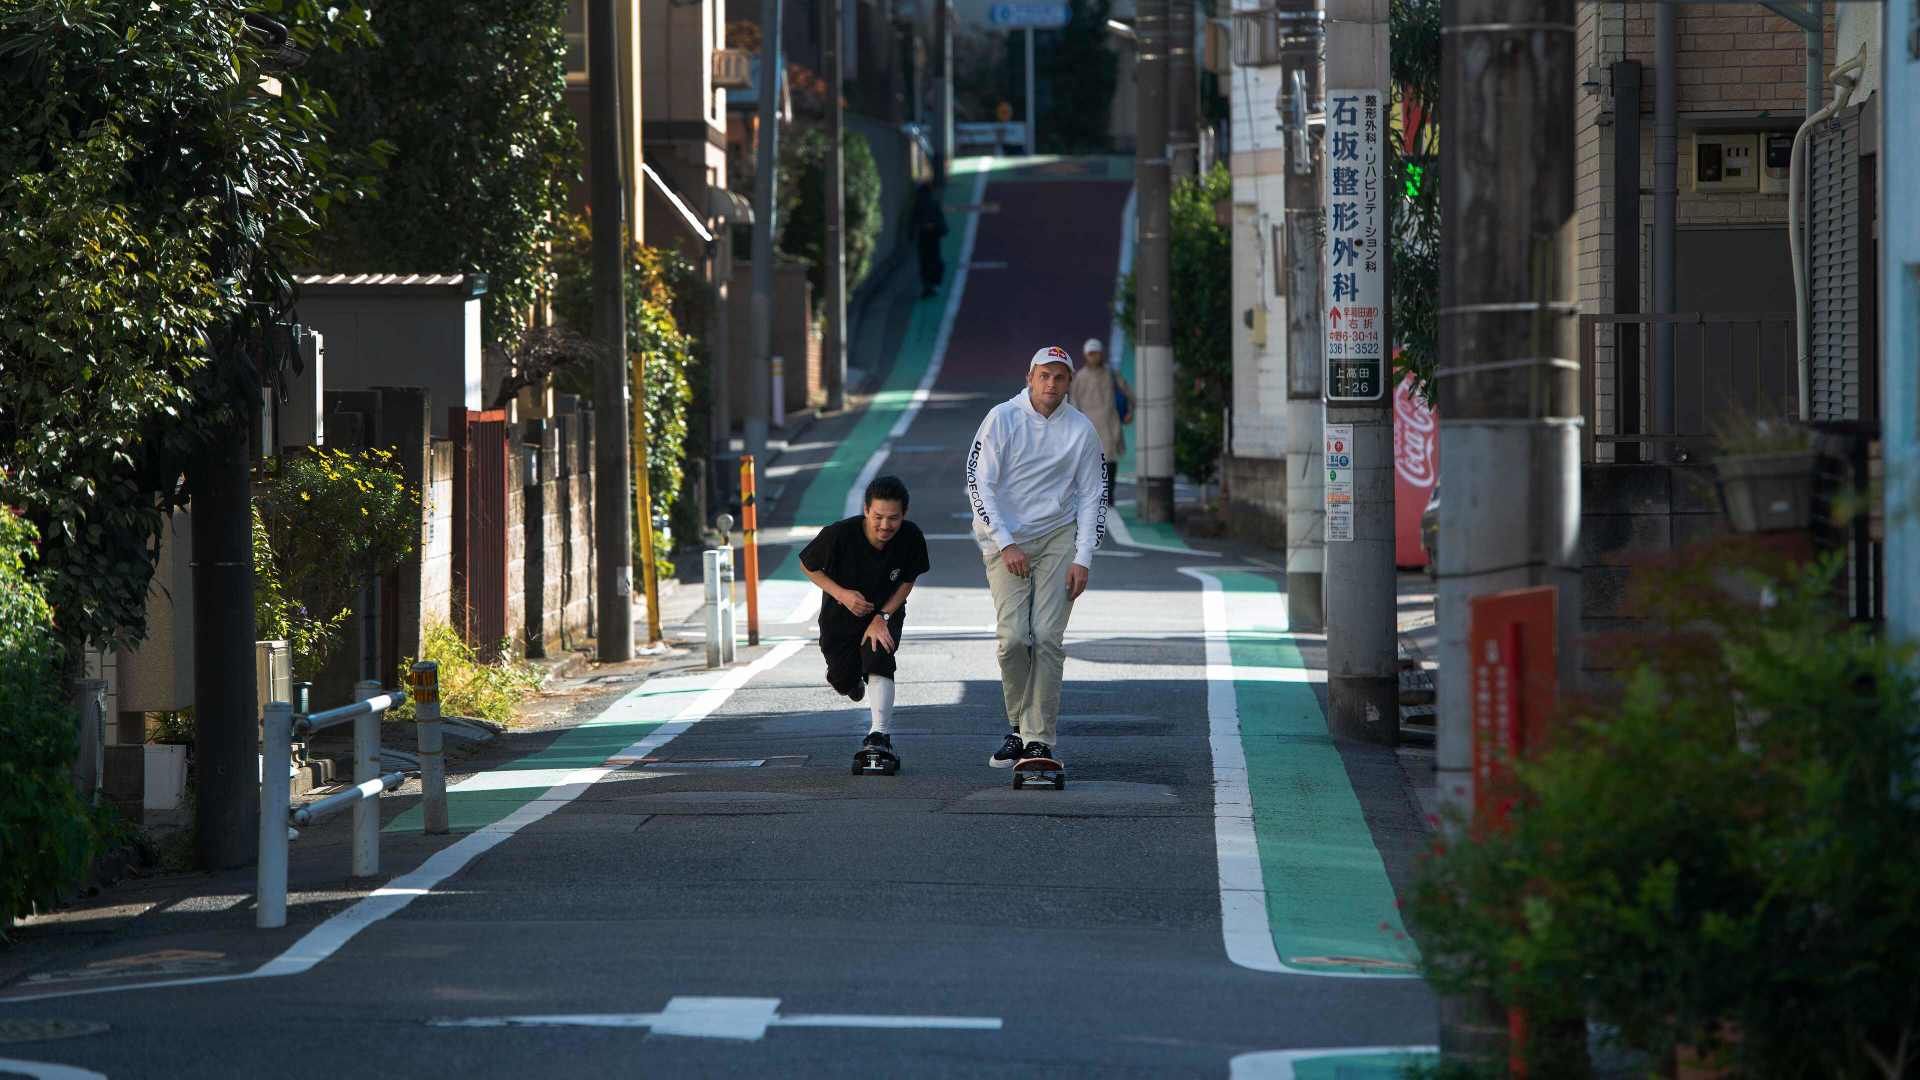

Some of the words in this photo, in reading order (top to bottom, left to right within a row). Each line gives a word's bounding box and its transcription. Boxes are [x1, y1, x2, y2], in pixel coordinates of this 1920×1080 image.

[1365, 95, 1377, 273] 整形外科・リハビリテーション科
[1332, 95, 1359, 302] 石坂整形外科
[1329, 343, 1379, 354] 3361-3522
[1336, 367, 1369, 378] 上高田
[1337, 383, 1369, 393] 1-26
